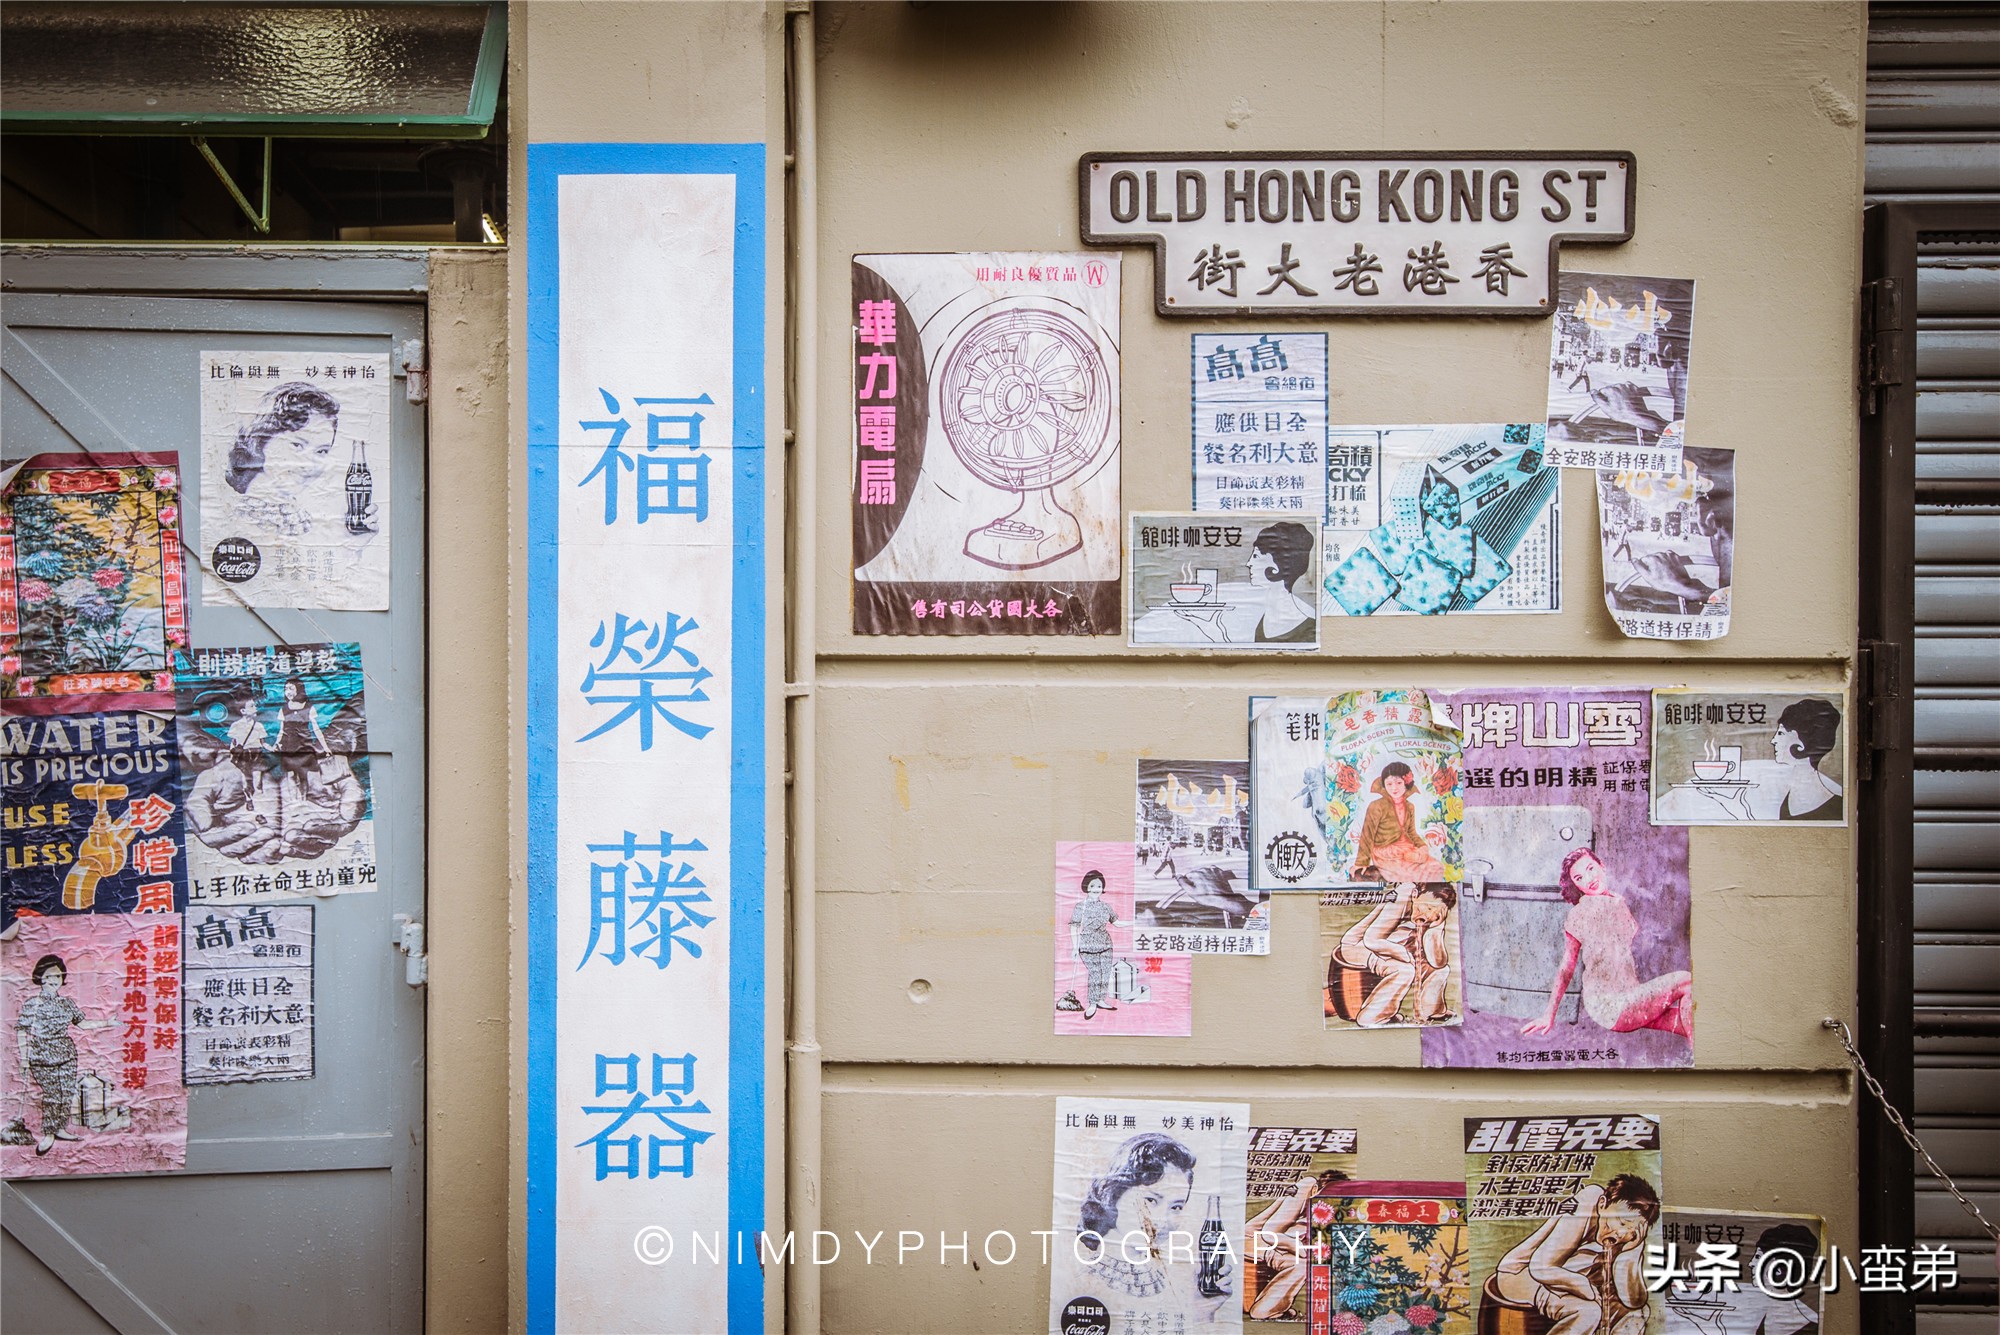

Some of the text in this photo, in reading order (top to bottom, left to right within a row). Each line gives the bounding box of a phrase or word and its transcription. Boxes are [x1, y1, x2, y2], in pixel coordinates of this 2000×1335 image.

[1110, 169, 1207, 223] OLD
[1225, 169, 1361, 223] HONG
[1379, 169, 1519, 223] KONG
[859, 299, 897, 505] 華力電扇
[0, 714, 166, 755] WATER
[1341, 728, 1395, 751] FLORAL SCENTS
[1394, 740, 1451, 751] FLORAL SCENTS
[1, 749, 169, 786] IS PRECIOUS
[574, 387, 716, 1181] 福榮藤器
[4, 803, 70, 829] USE
[6, 843, 73, 869] LESS
[1247, 1154, 1312, 1167] 快打防疫
